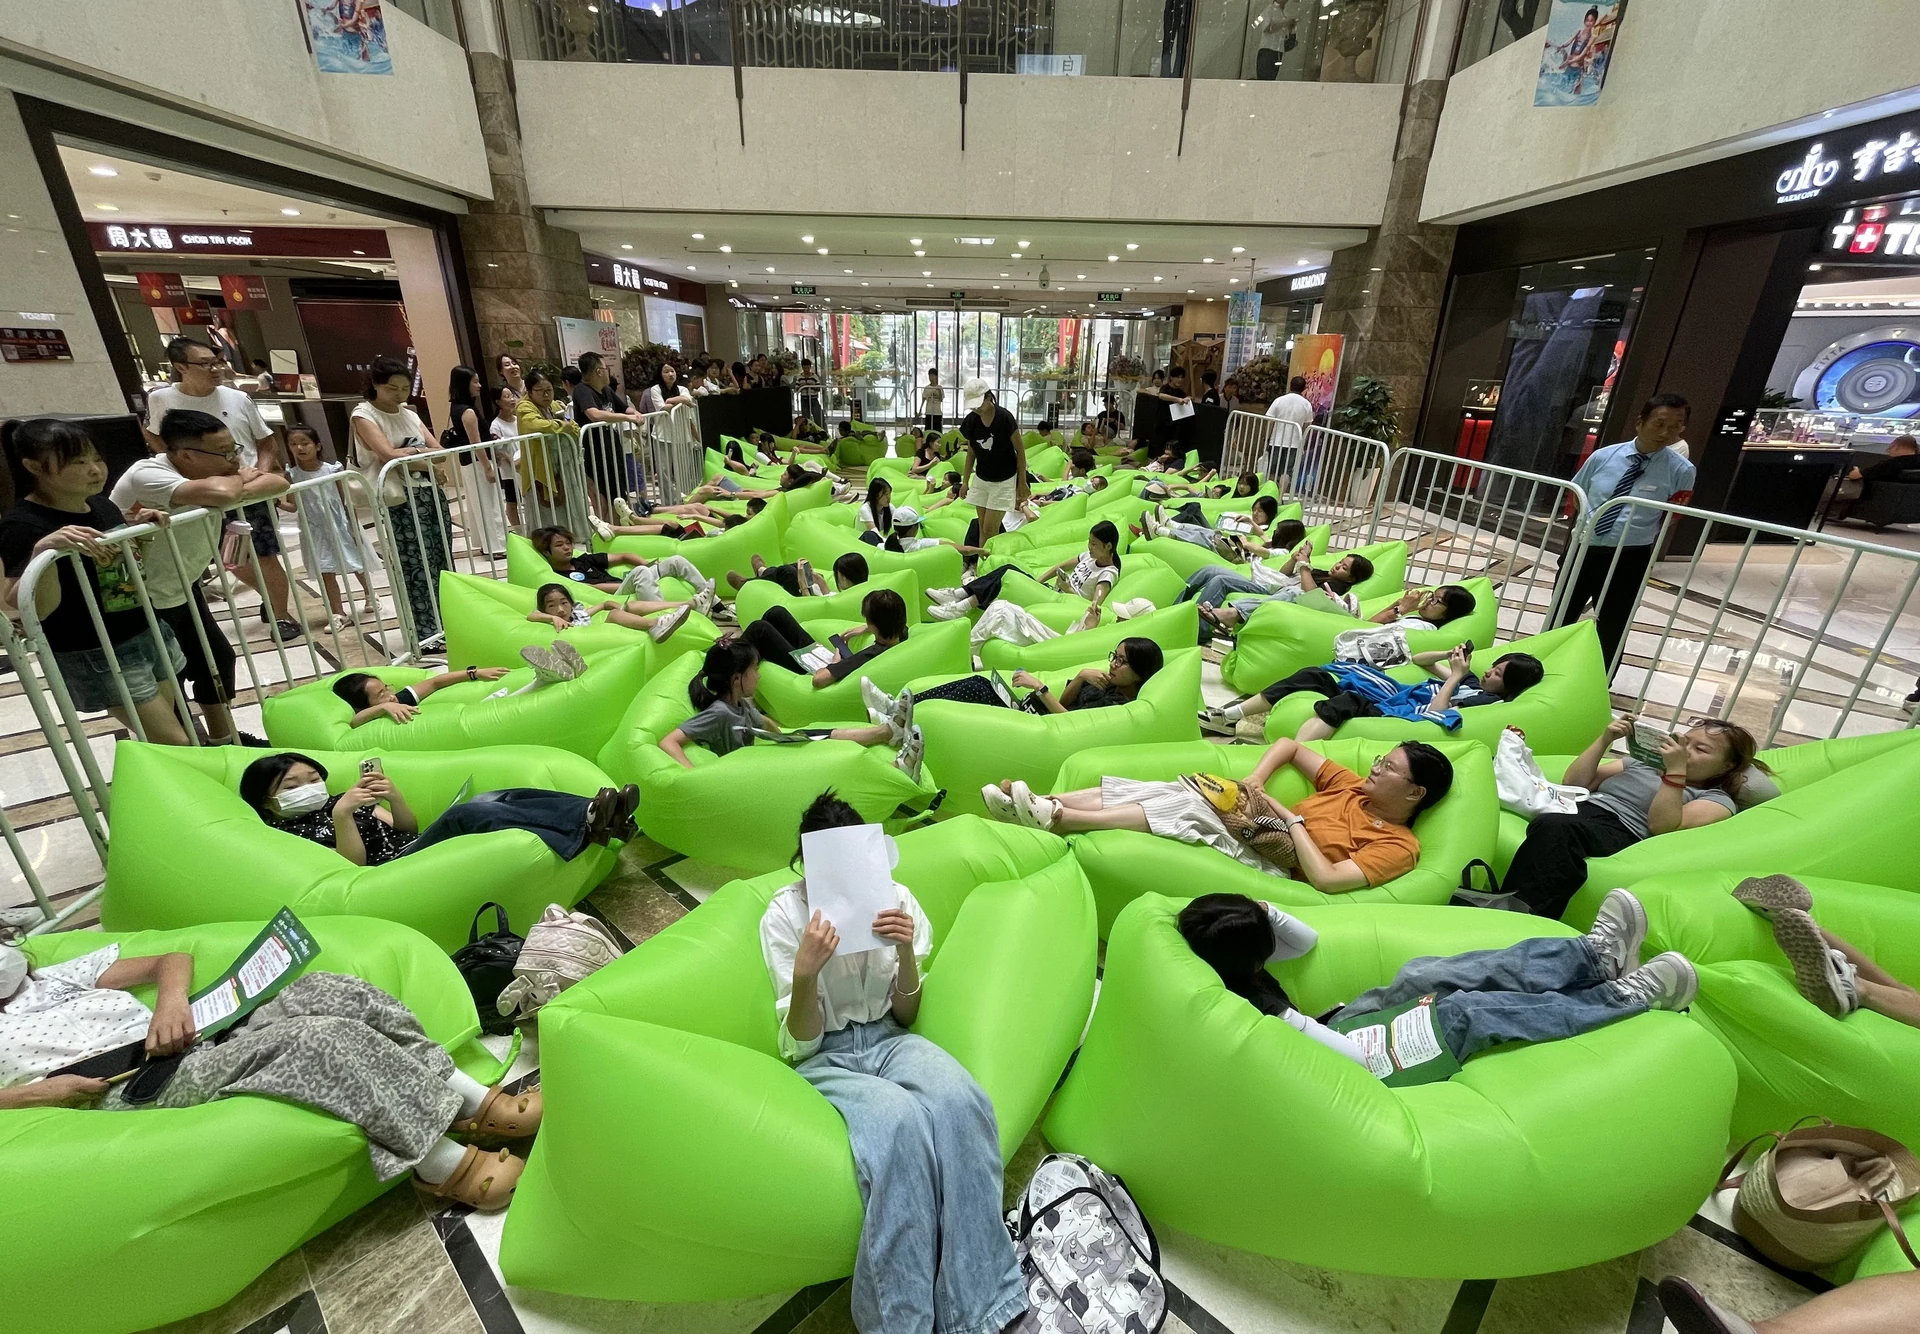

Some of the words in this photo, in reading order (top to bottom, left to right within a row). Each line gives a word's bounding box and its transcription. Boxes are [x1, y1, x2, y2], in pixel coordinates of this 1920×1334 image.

[1776, 189, 1821, 204] HARMONY
[107, 225, 174, 249] 周大福
[181, 234, 210, 245] CHOW
[209, 234, 226, 245] TAI
[1883, 222, 1920, 255] TI
[613, 263, 641, 290] 周大福
[1291, 272, 1327, 291] HARMONY
[1813, 345, 1846, 371] FIYTA
